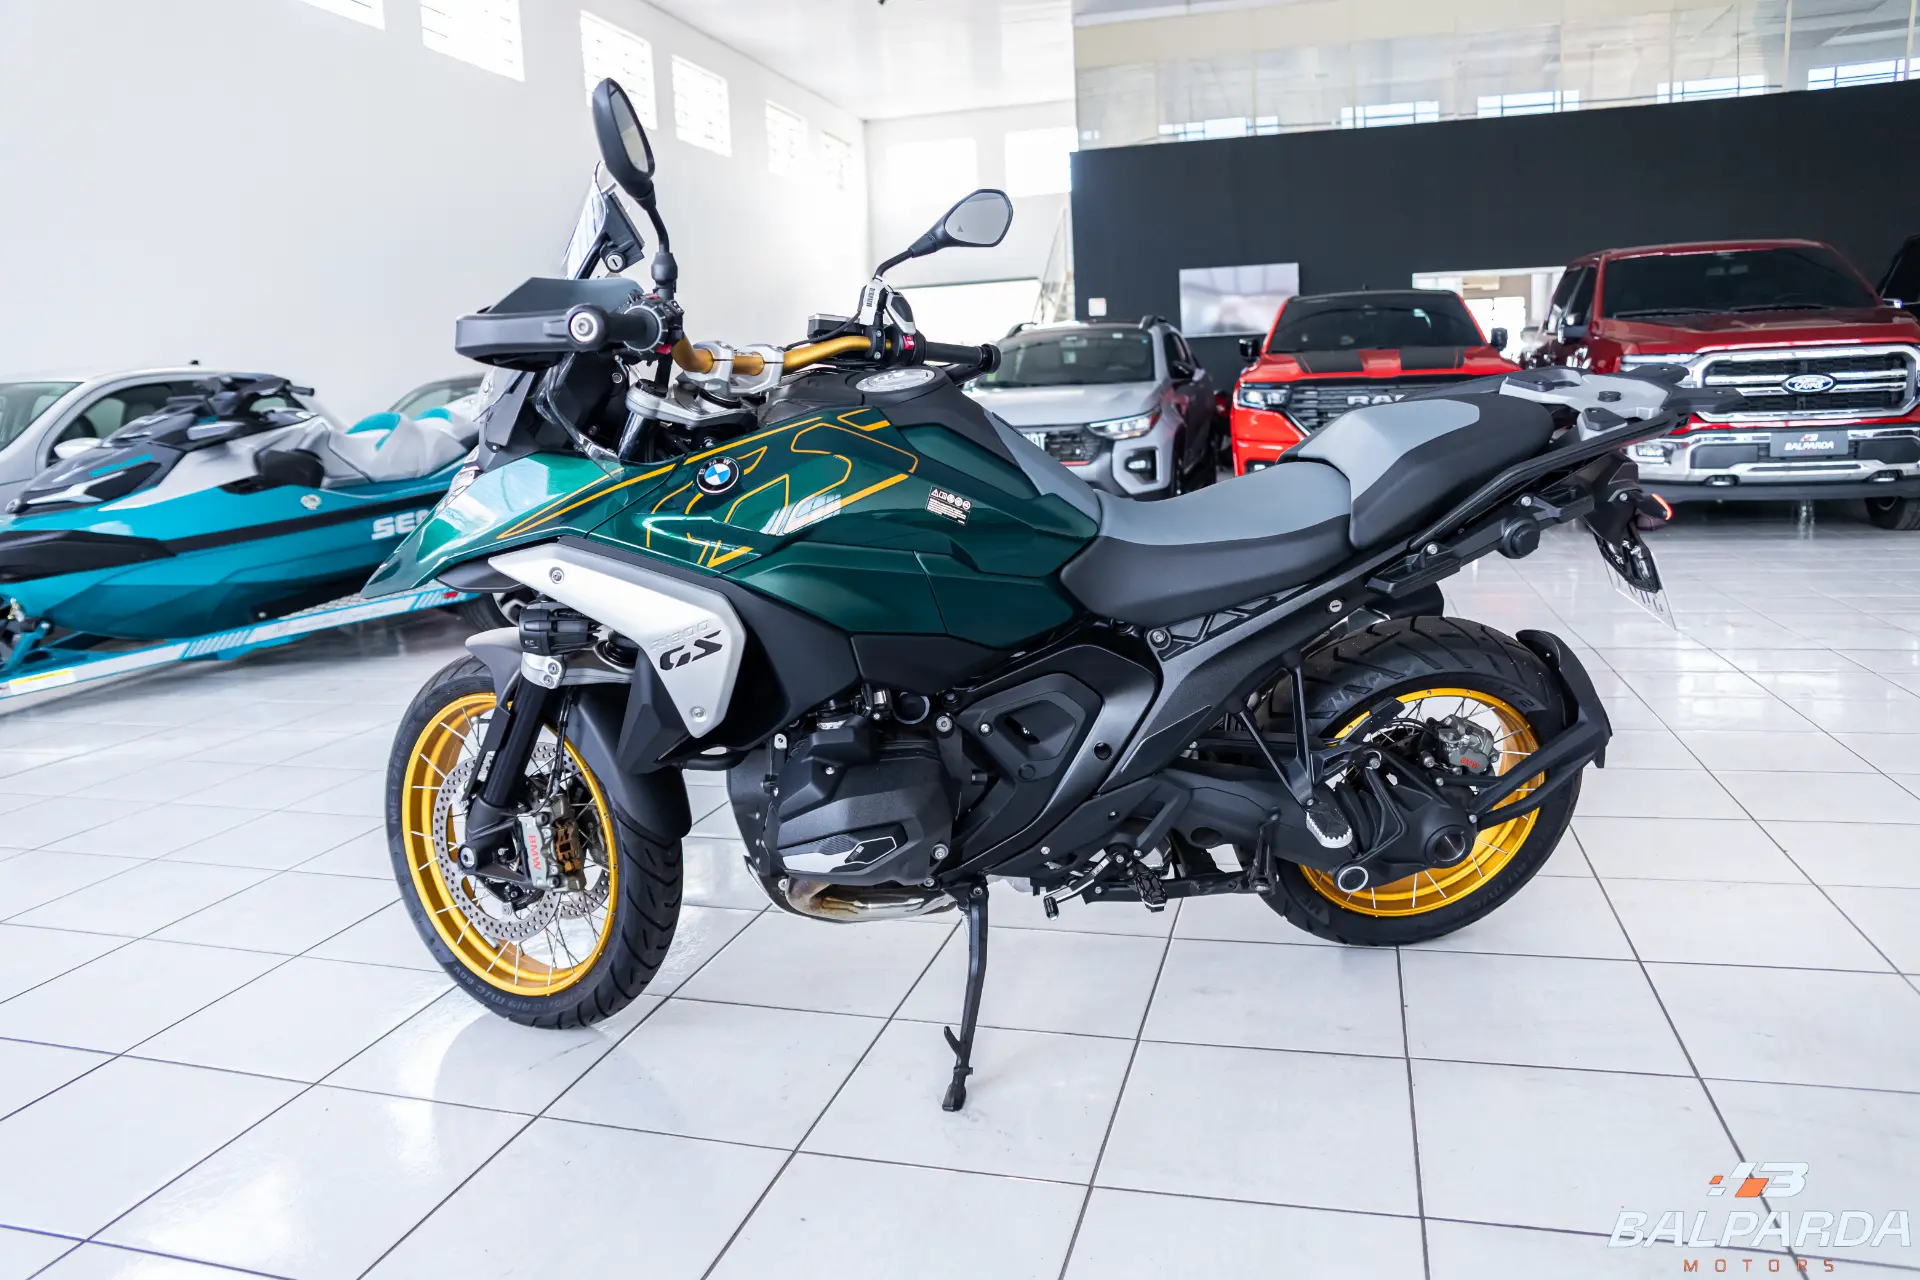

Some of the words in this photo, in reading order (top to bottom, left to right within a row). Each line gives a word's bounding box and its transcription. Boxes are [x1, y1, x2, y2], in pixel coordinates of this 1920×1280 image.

[1783, 440, 1835, 451] BALPARDA
[659, 629, 723, 671] GS
[1459, 756, 1480, 769] BMW
[528, 834, 543, 871] BMW
